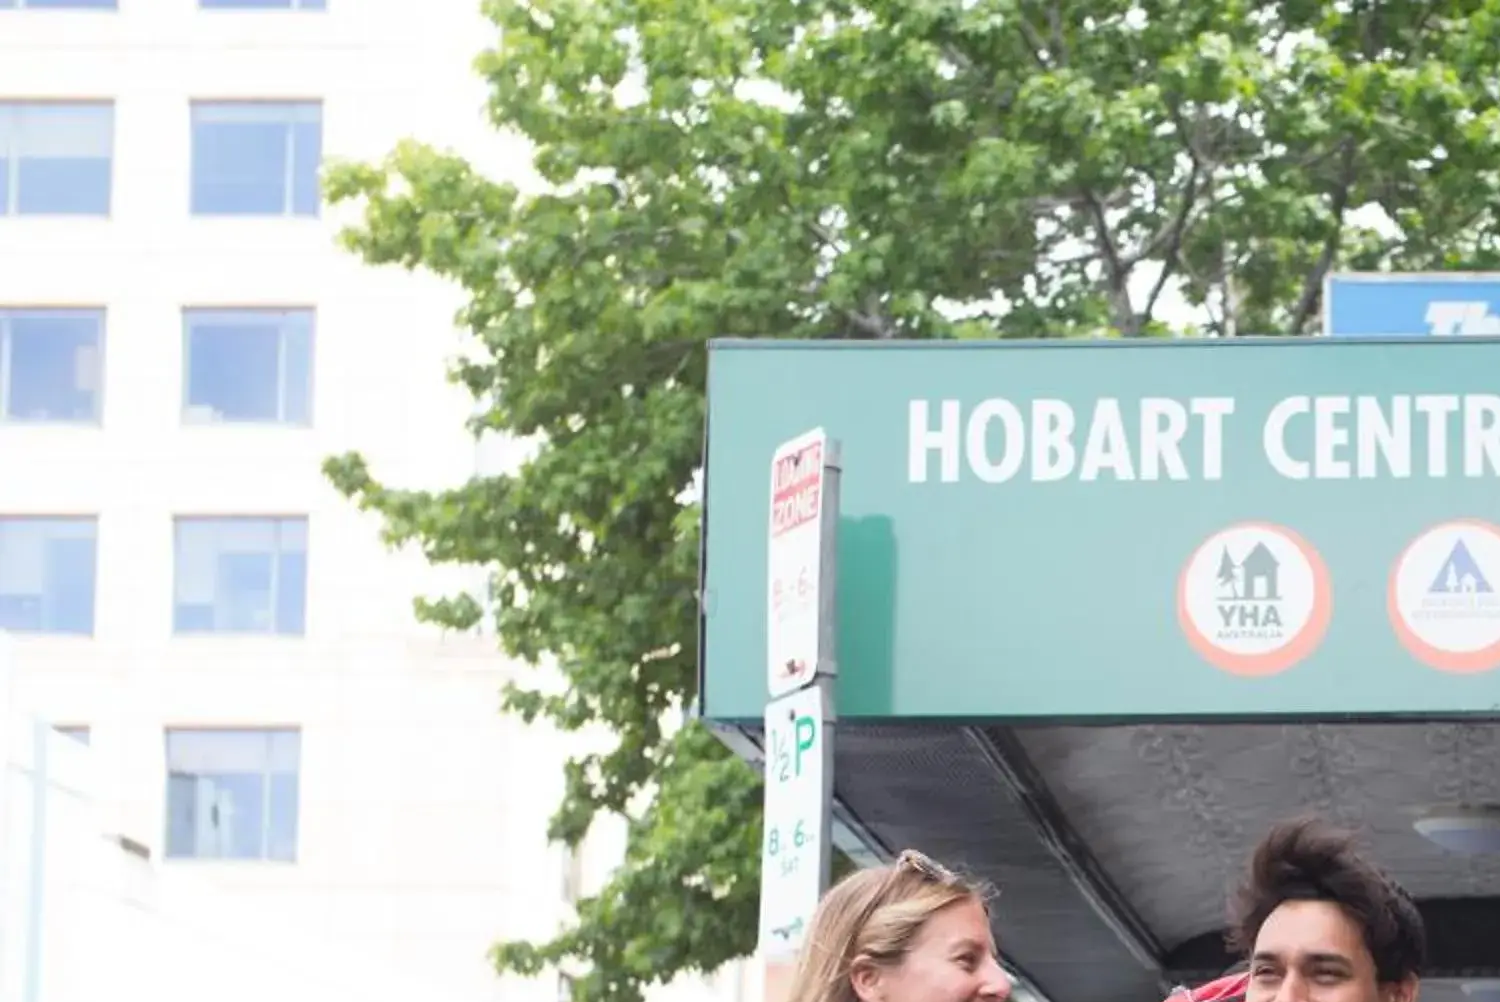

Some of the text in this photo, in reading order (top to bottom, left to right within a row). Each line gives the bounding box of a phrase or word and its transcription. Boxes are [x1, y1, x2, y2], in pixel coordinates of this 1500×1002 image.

[908, 396, 1235, 483] HOBART
[774, 484, 820, 529] ZONE
[1217, 604, 1283, 627] YHA
[1216, 629, 1284, 640] AUSTRALIA
